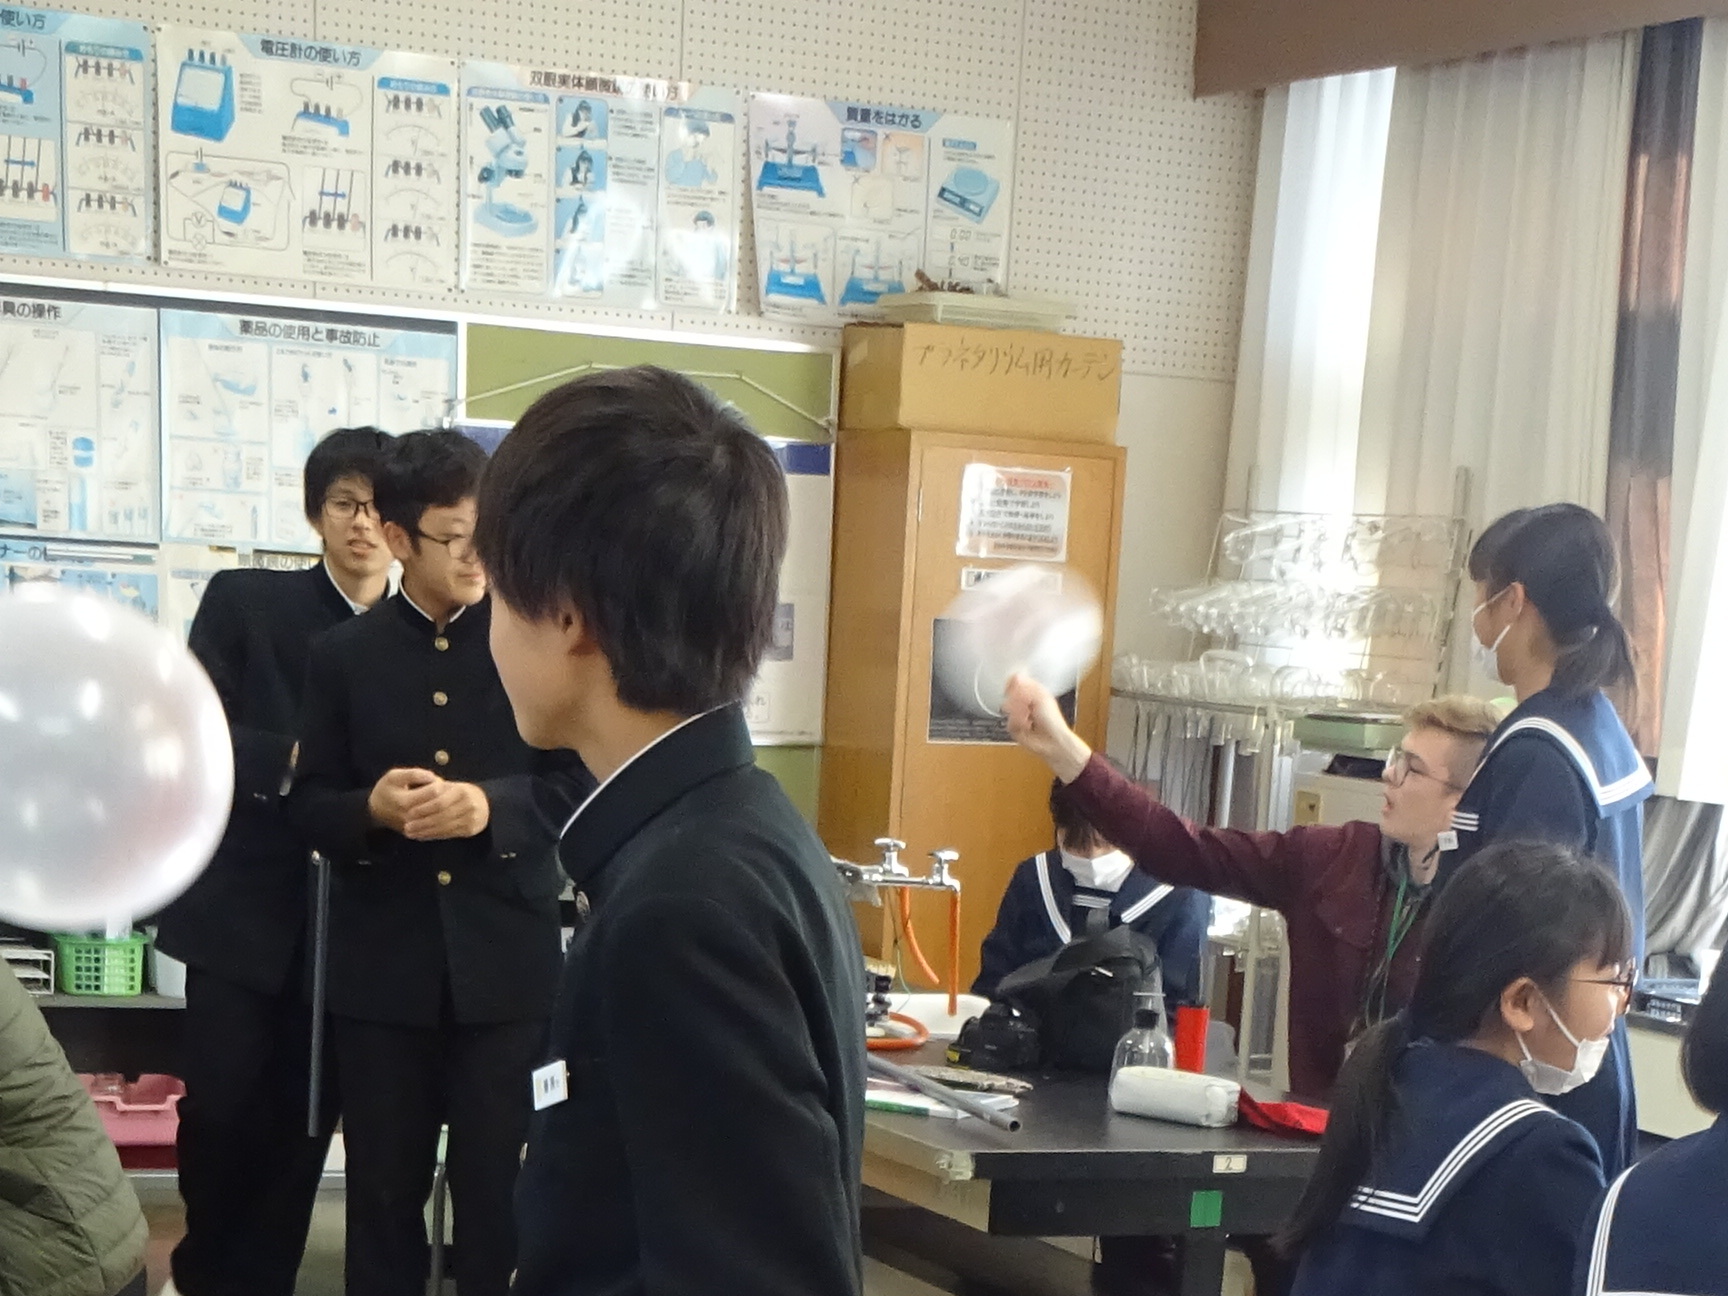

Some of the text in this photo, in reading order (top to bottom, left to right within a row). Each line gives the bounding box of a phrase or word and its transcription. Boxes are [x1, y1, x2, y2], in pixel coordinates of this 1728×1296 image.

[259, 38, 362, 67] 電圧計の使い方
[846, 106, 923, 130] 質量をはかる
[238, 319, 381, 347] 薬品の使用と事故防止
